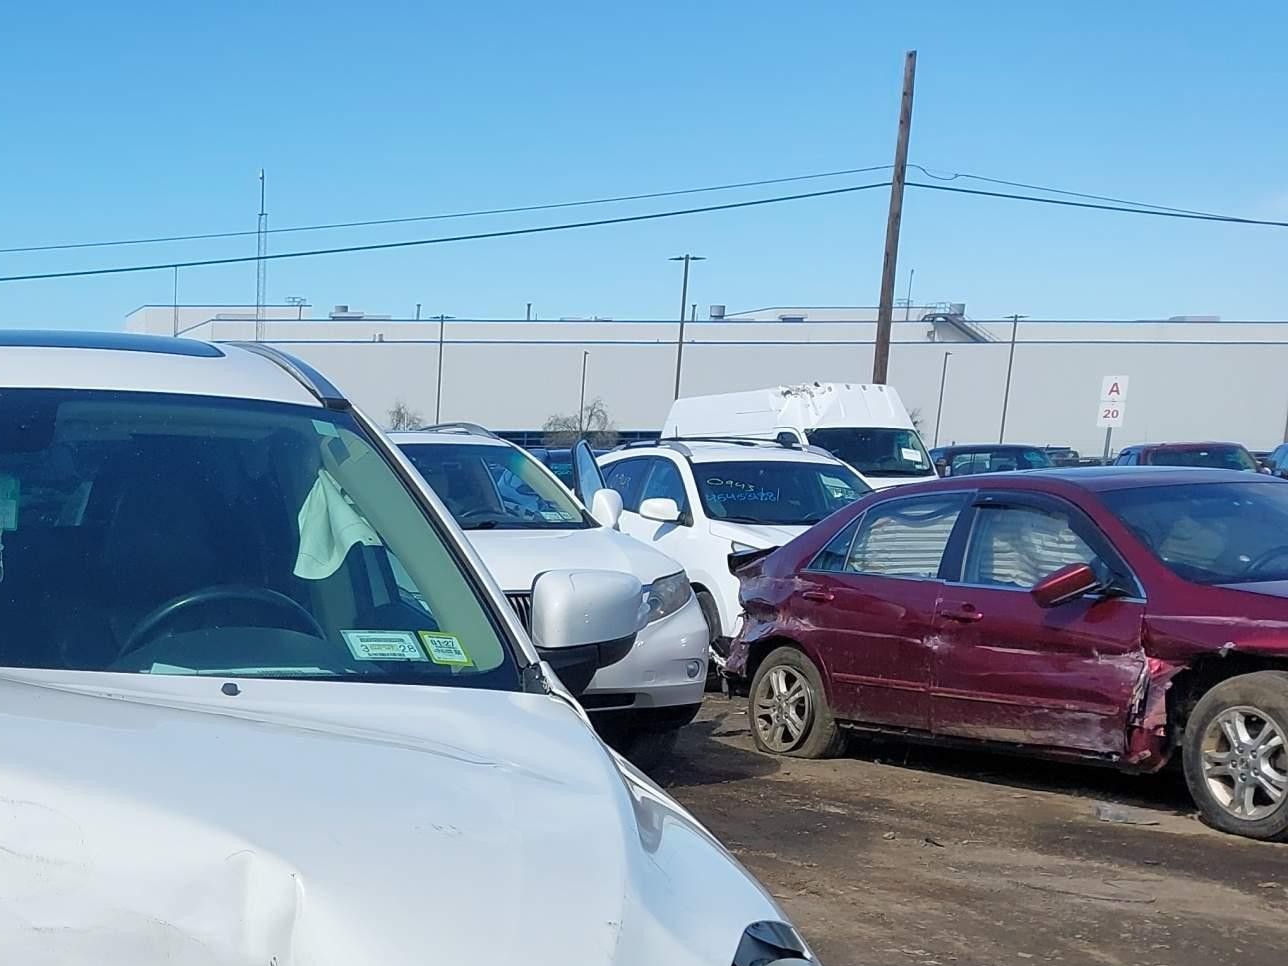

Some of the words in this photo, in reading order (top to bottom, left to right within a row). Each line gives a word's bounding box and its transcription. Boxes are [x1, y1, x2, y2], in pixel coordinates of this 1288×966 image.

[1108, 382, 1120, 396] A
[1103, 409, 1119, 419] 20
[399, 644, 416, 653] 28
